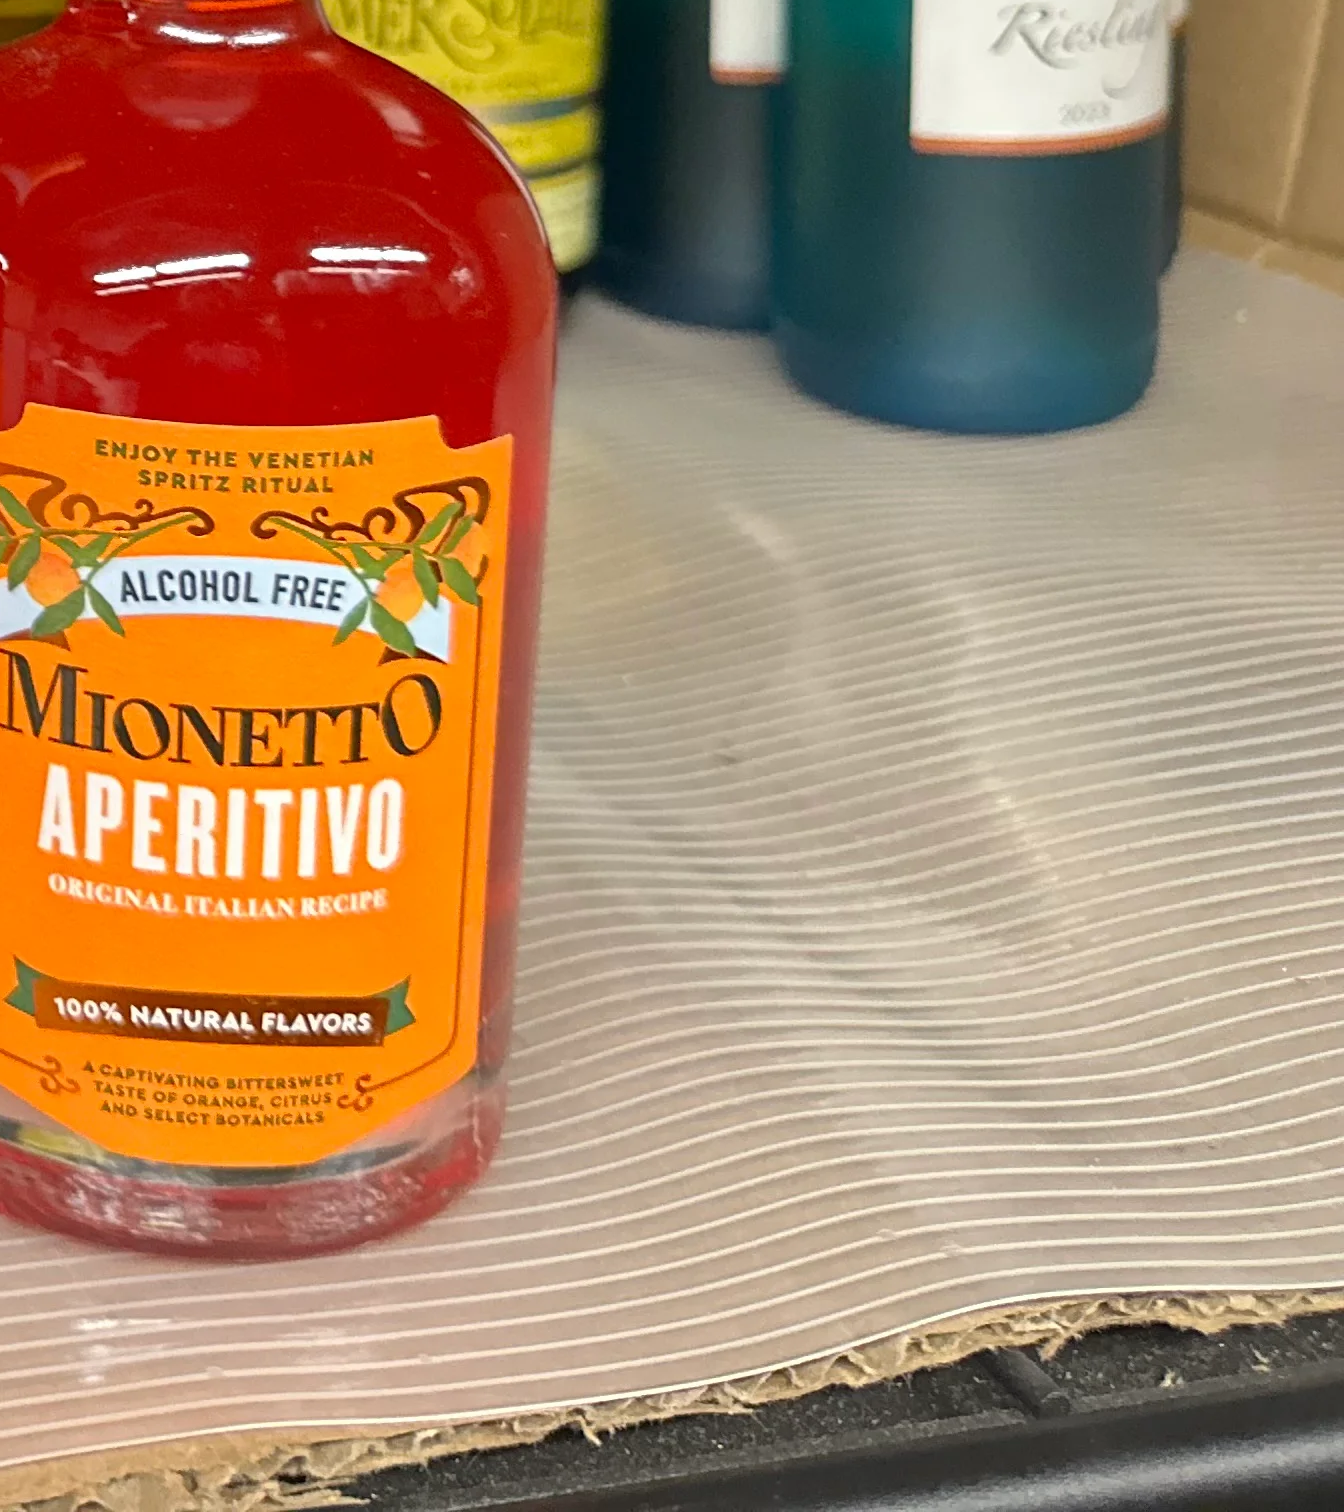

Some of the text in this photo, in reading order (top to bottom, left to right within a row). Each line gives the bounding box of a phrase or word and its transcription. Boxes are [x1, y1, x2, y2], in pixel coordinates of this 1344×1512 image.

[95, 439, 375, 469] ENJOY THE VENETIAN
[138, 469, 334, 494] SPRITZ RITUAL
[120, 569, 347, 612] ALCOHOL FREE
[37, 763, 404, 880] APERITIVO
[48, 872, 388, 919] ORIGINAL ITALIAN RECIPE
[54, 996, 373, 1036] 100% NATURAL FLAVORS
[83, 1060, 345, 1090] A CAPTIVATING BITTERSWEET
[93, 1080, 147, 1101] TASTE
[152, 1090, 177, 1104] OF
[269, 1092, 332, 1108] CITRUS
[100, 1100, 325, 1127] AND SELECT BOTANICALS
